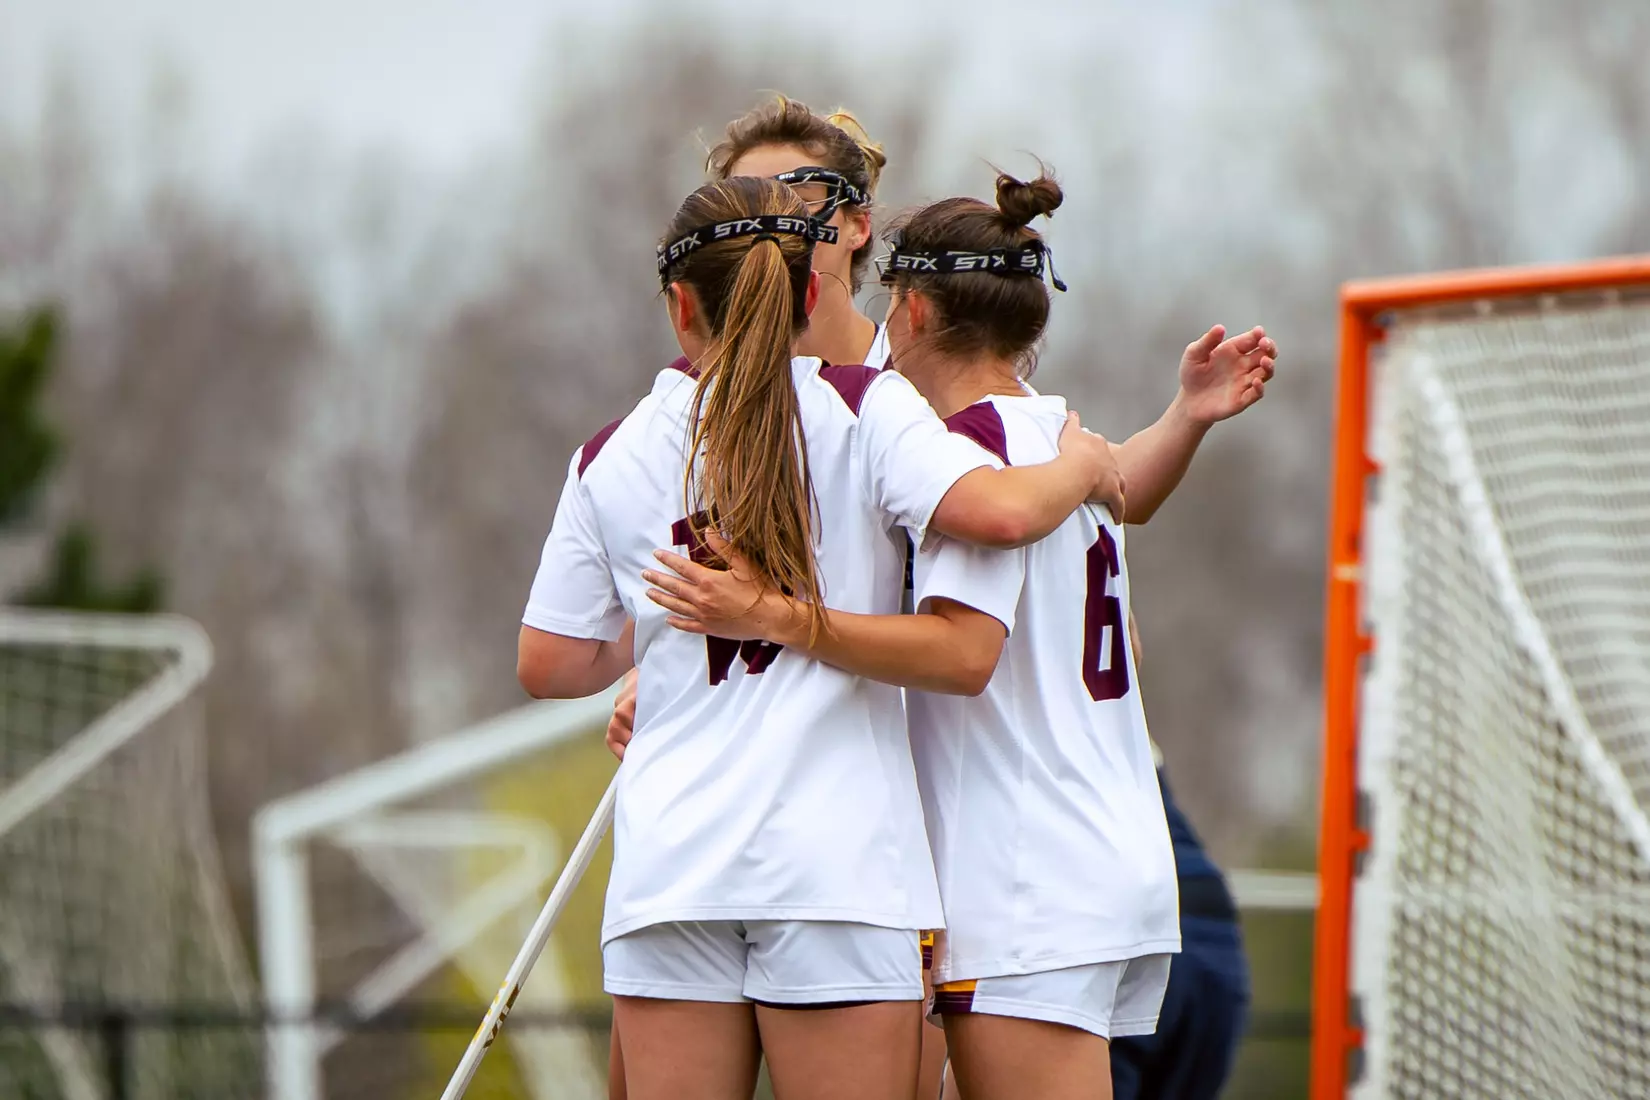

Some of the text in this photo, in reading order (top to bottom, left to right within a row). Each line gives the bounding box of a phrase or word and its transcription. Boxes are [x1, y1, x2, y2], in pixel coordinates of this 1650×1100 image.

[670, 232, 702, 260] STX
[714, 217, 763, 239] STX
[817, 226, 839, 242] ST
[896, 254, 938, 271] STX
[952, 254, 1006, 271] STX
[1082, 523, 1130, 702] 6
